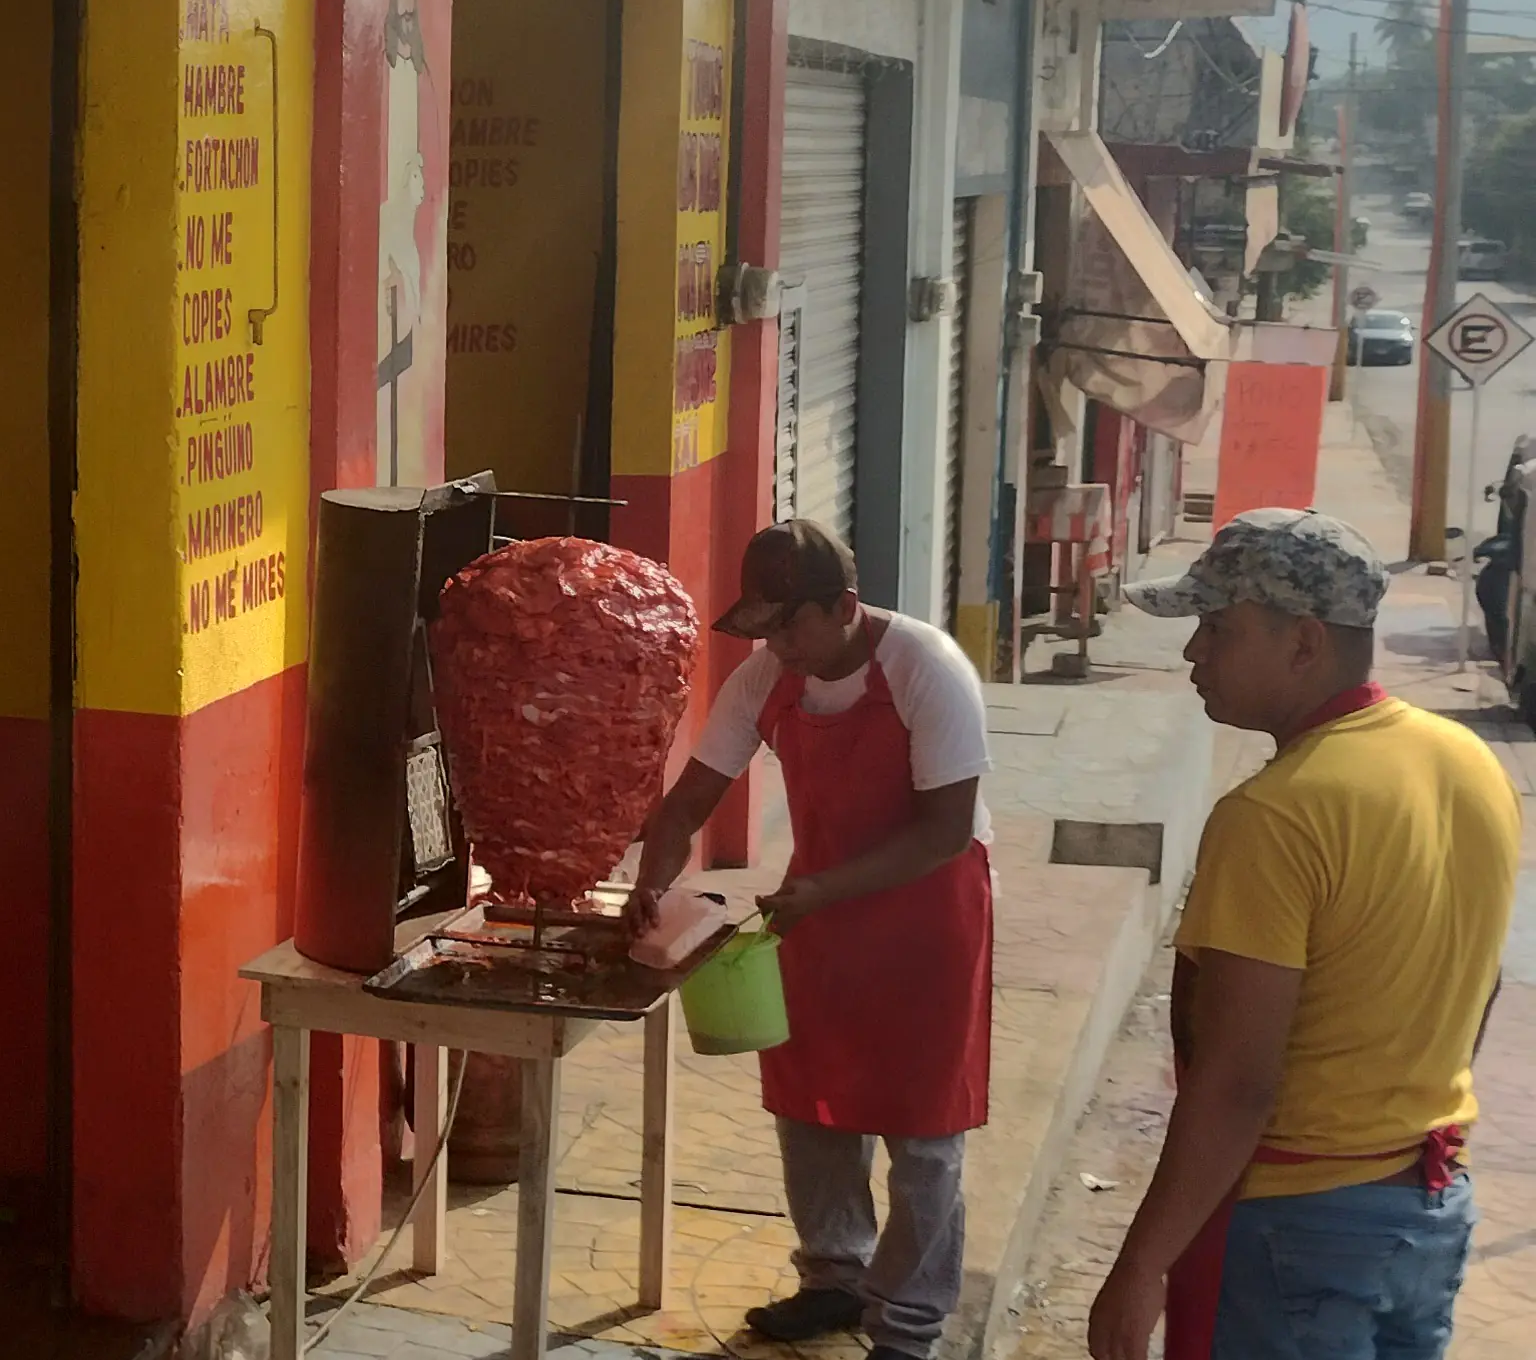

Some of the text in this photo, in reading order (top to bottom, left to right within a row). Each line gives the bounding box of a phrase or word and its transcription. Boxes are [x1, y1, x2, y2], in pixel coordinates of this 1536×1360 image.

[184, 63, 245, 118] HAMBRE
[451, 116, 540, 147] AMBRE
[449, 158, 521, 190] OPIES
[241, 549, 286, 615] MIRES
